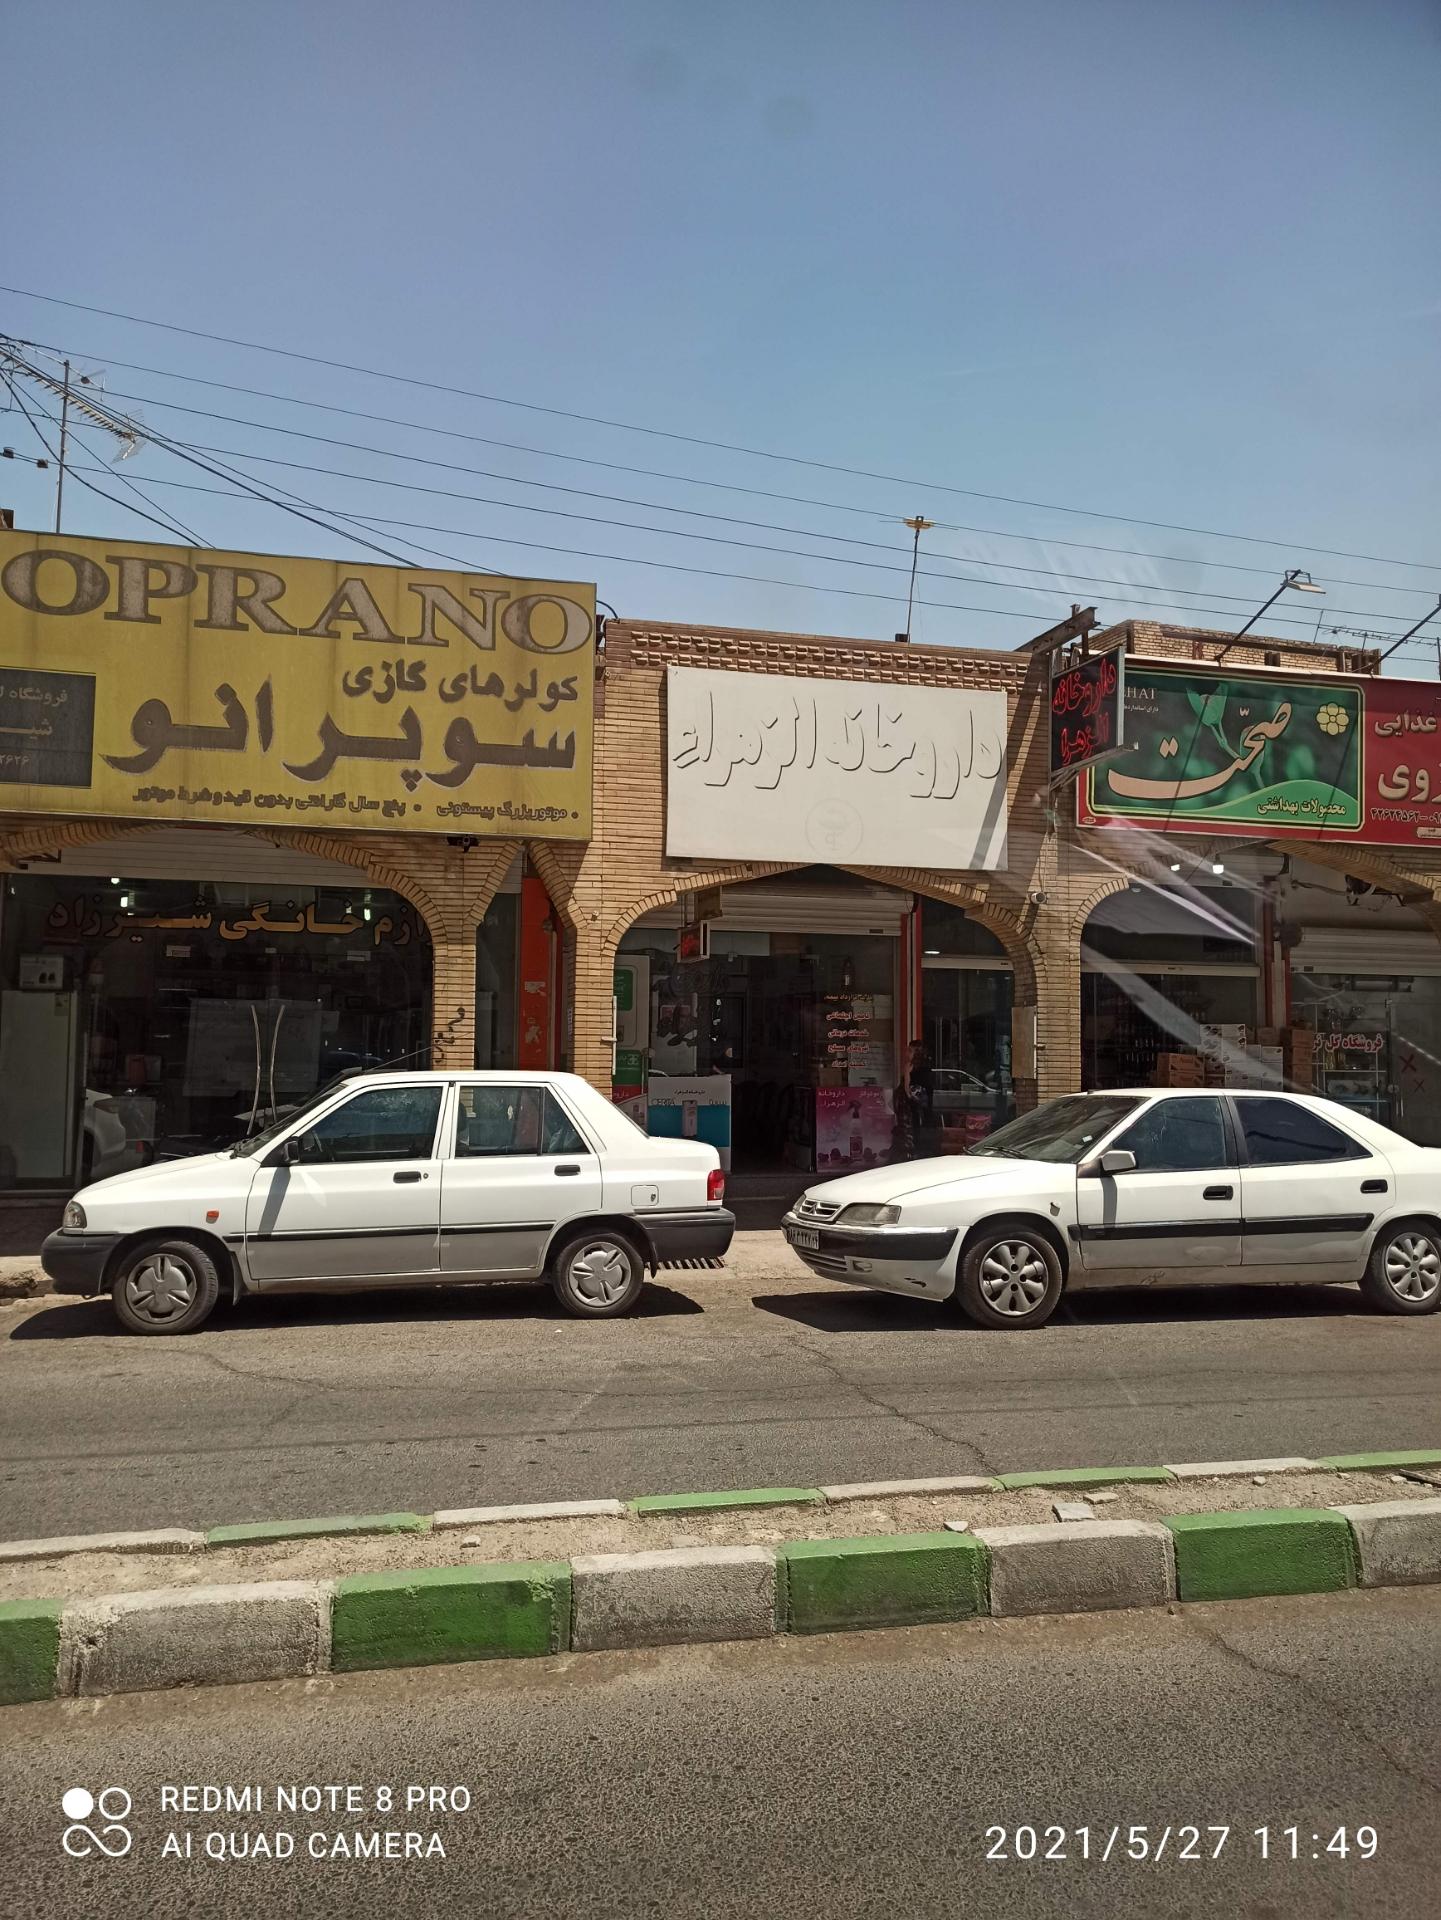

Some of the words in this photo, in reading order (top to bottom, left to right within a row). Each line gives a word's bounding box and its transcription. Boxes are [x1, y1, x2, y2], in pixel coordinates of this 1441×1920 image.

[342, 658, 427, 704] گازی
[439, 665, 578, 712] کولرهای
[1053, 658, 1116, 716] داروخانه
[9, 687, 69, 707] فروشگاه
[1124, 687, 1156, 698] HAT
[98, 674, 577, 792] سوپرانو
[1374, 709, 1438, 737] غذایی
[824, 701, 1002, 799] داروخانه
[348, 795, 379, 812] سال
[382, 799, 406, 818] پنج
[436, 801, 494, 820] پیستونی
[1257, 796, 1299, 815] بهداشتی
[1301, 797, 1346, 817] محصولات
[218, 899, 365, 941] خانگی
[1325, 1033, 1342, 1053] گل
[1341, 1032, 1384, 1053] فروشگاه
